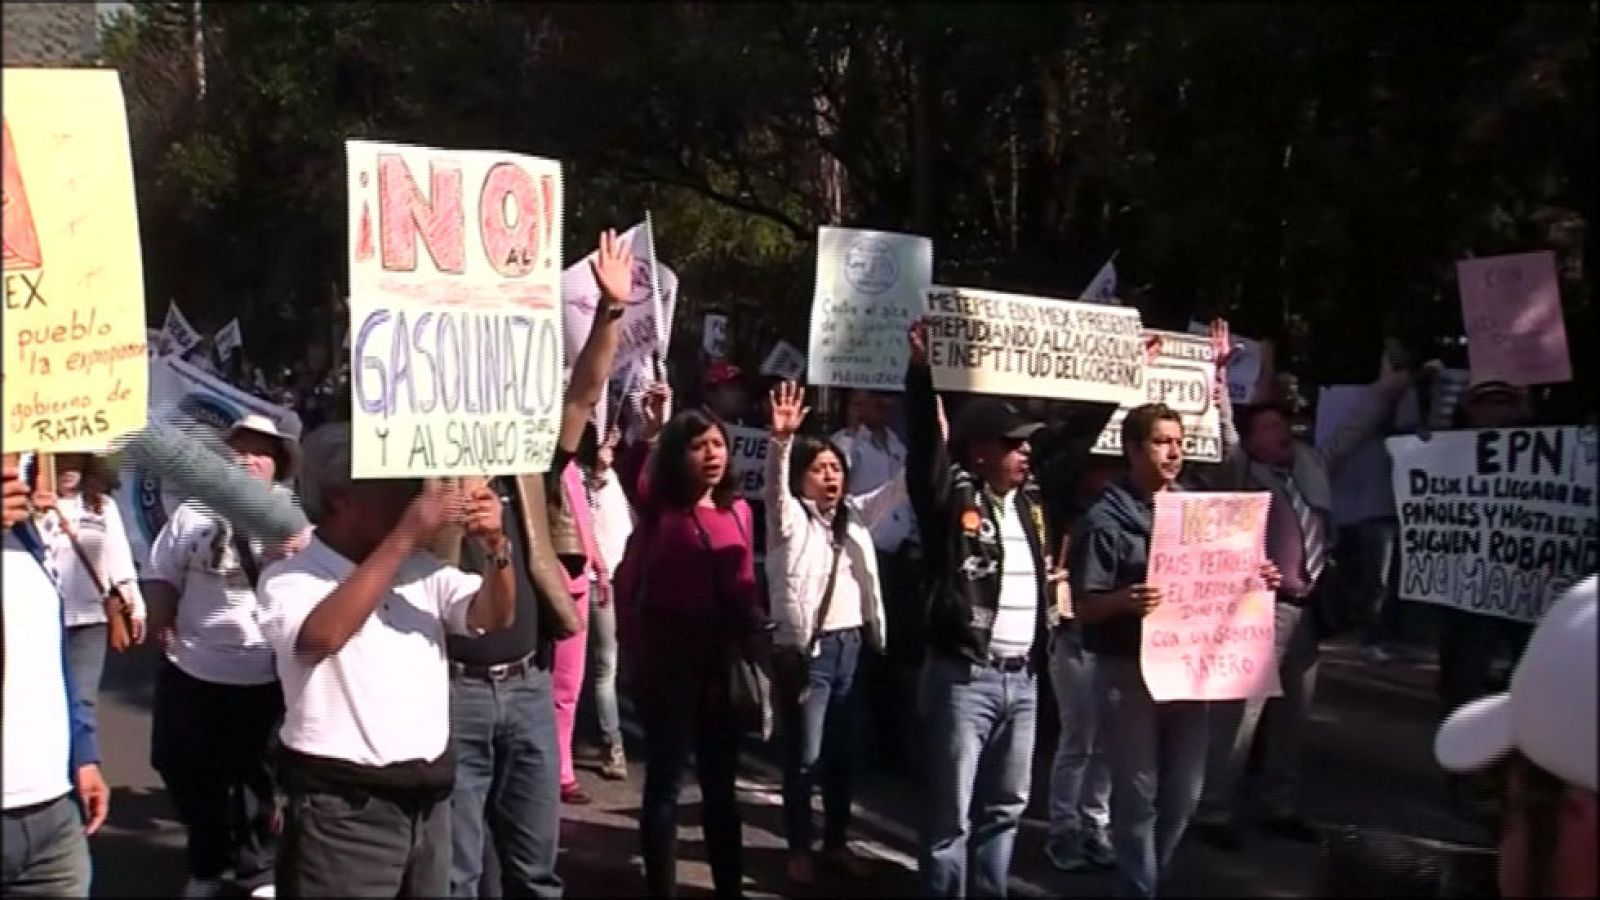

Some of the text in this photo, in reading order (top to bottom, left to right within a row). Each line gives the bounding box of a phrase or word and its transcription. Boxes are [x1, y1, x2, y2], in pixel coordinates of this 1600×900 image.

[506, 247, 531, 266] AL
[927, 288, 1006, 320] METEPEC
[18, 307, 112, 361] pueblo
[30, 352, 51, 375] la
[353, 308, 558, 420] GASOLINAZO
[931, 341, 944, 367] E
[12, 379, 132, 434] gobierno de
[32, 409, 110, 441] RATAS
[376, 427, 390, 467] Y
[445, 420, 518, 472] SAQUEO
[1475, 429, 1564, 475] EPN
[1405, 528, 1482, 554] SIGUEN
